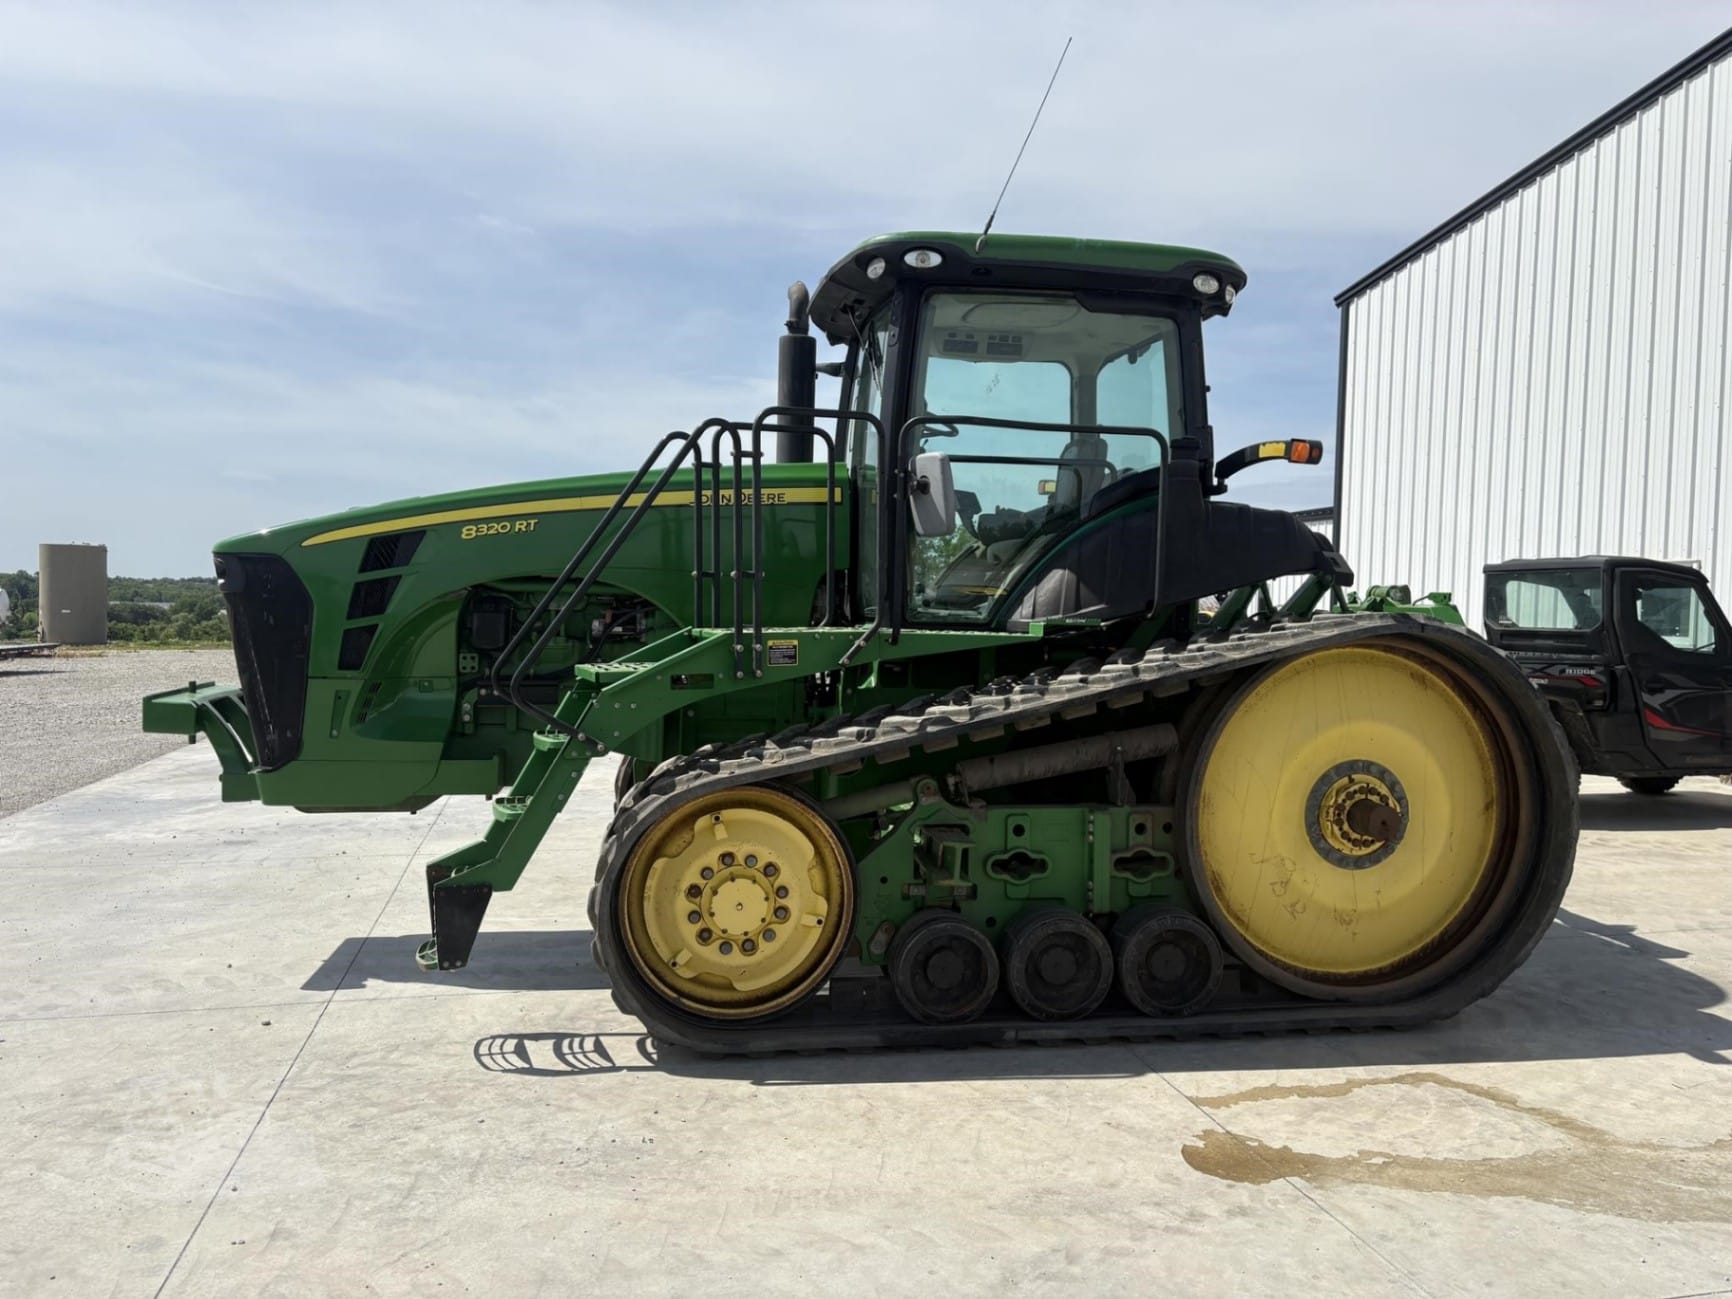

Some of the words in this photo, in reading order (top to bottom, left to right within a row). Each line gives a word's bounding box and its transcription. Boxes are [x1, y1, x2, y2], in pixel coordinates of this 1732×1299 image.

[689, 494, 732, 505] ON
[461, 521, 511, 539] 8320
[515, 519, 538, 532] RT
